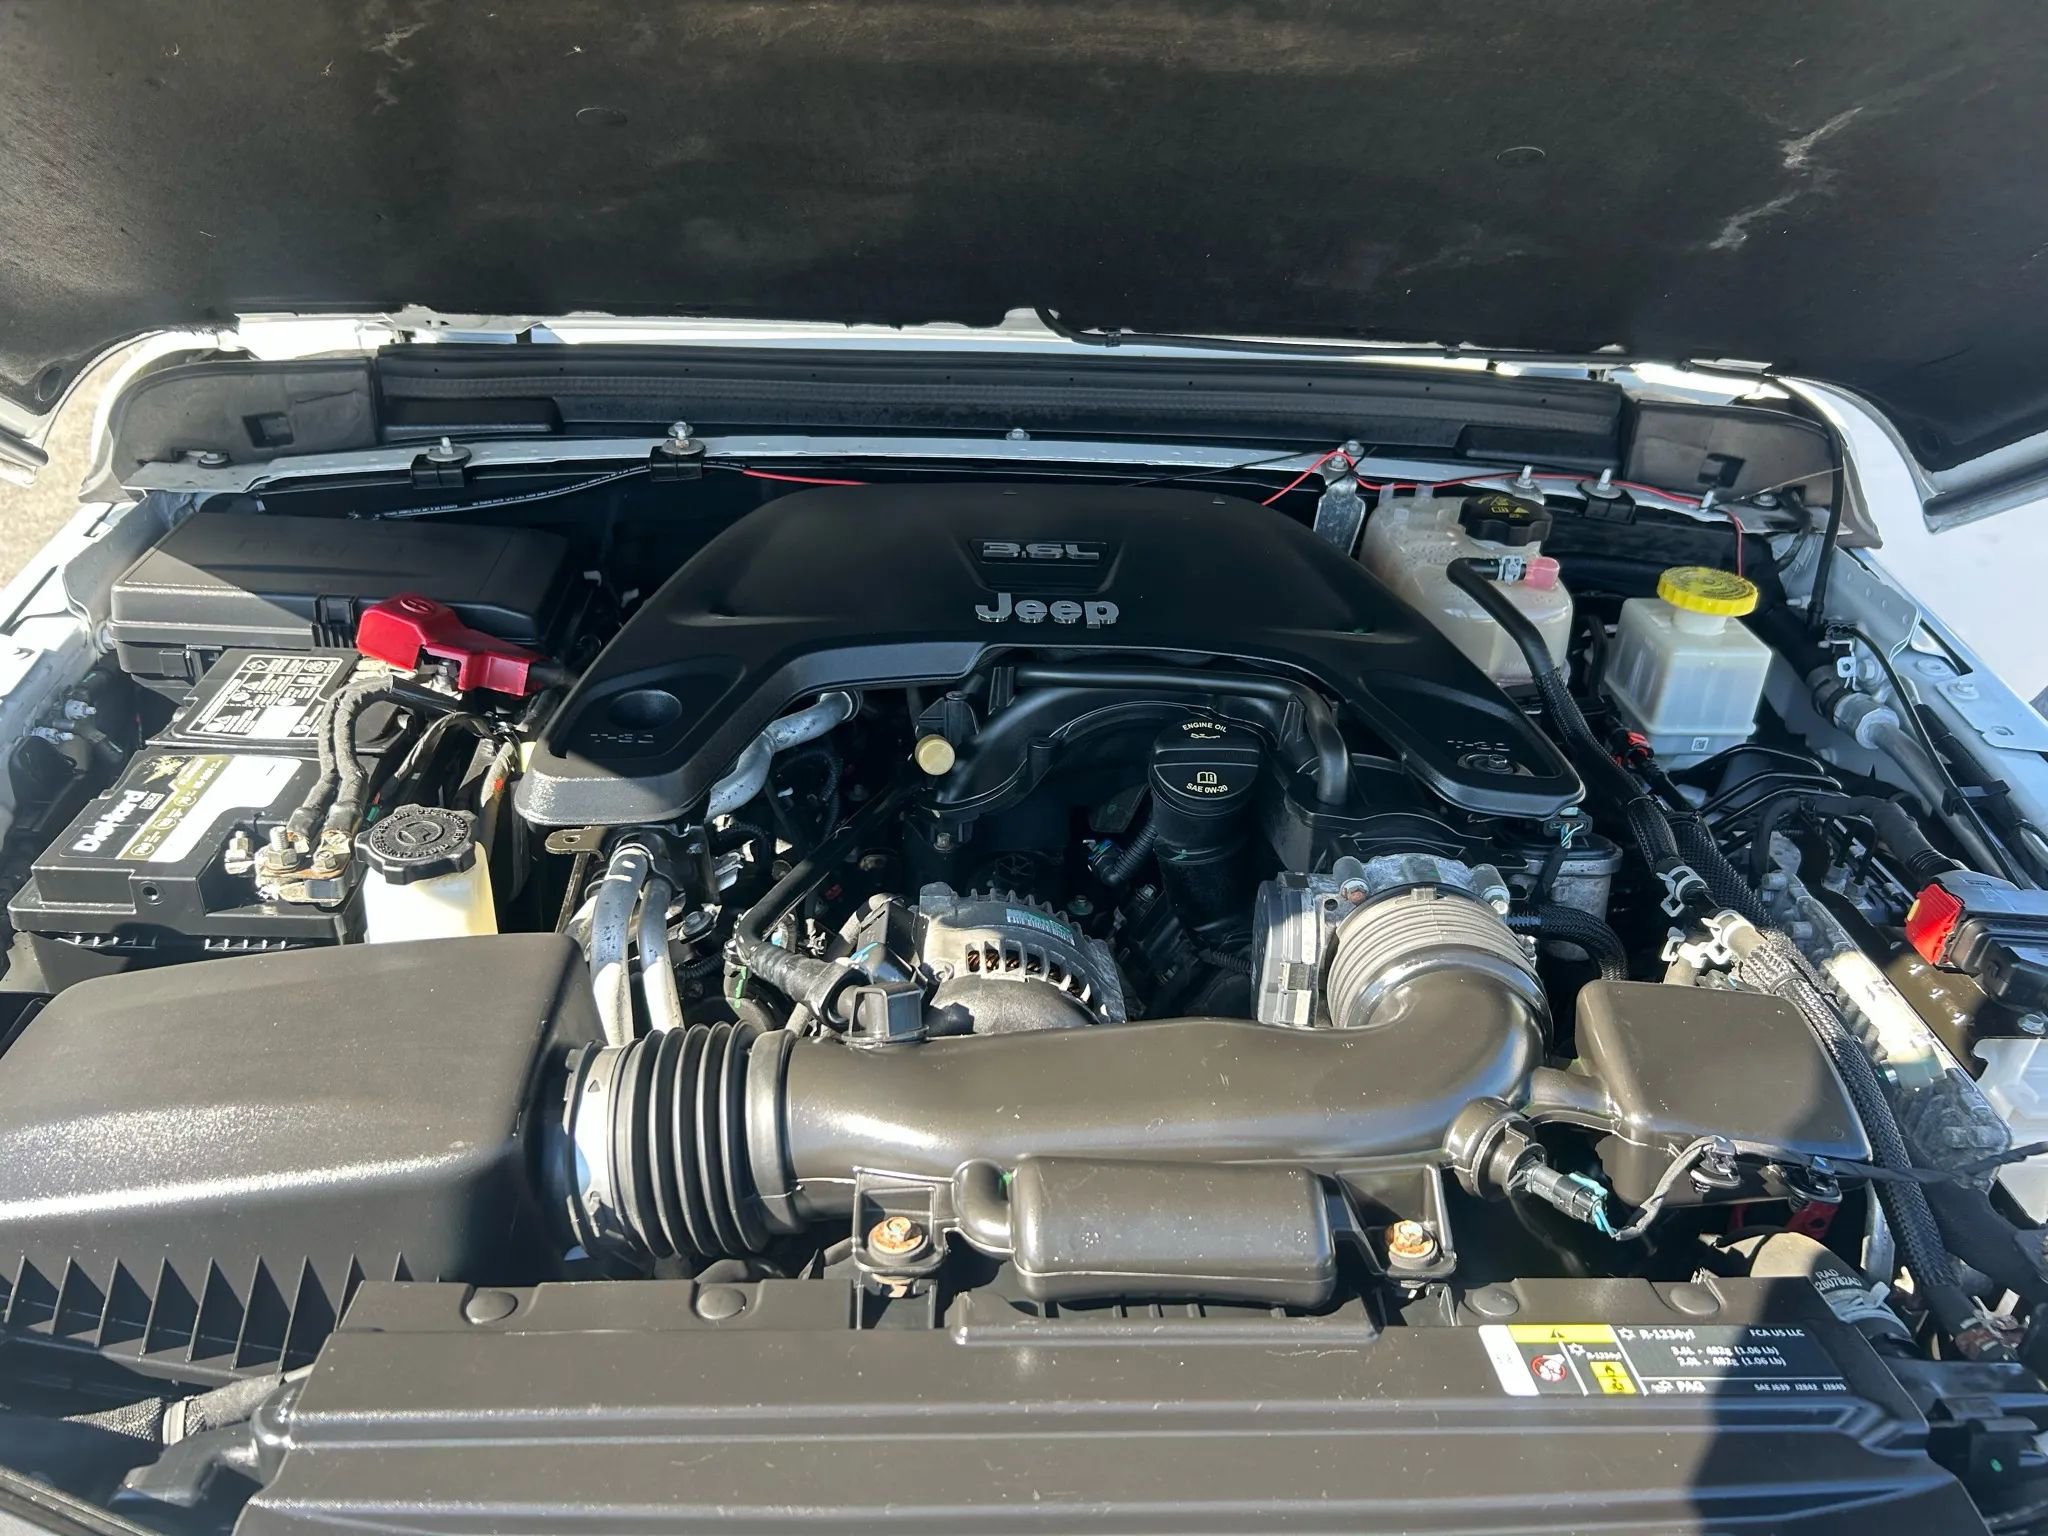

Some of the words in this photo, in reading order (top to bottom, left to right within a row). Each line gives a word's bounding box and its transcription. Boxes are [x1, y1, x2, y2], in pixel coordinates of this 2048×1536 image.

[982, 541, 1100, 560] 3.6L
[974, 592, 1120, 629] Jeep
[1182, 722, 1213, 731] ENGINE
[1214, 723, 1228, 733] OIL
[1186, 782, 1204, 793] SAE
[1204, 783, 1229, 794] 0W-20
[72, 789, 149, 853] DieHard
[1815, 1268, 1840, 1280] RAD
[1749, 1328, 1772, 1338] FCA
[1770, 1329, 1787, 1338] US
[1785, 1329, 1806, 1338] LLC
